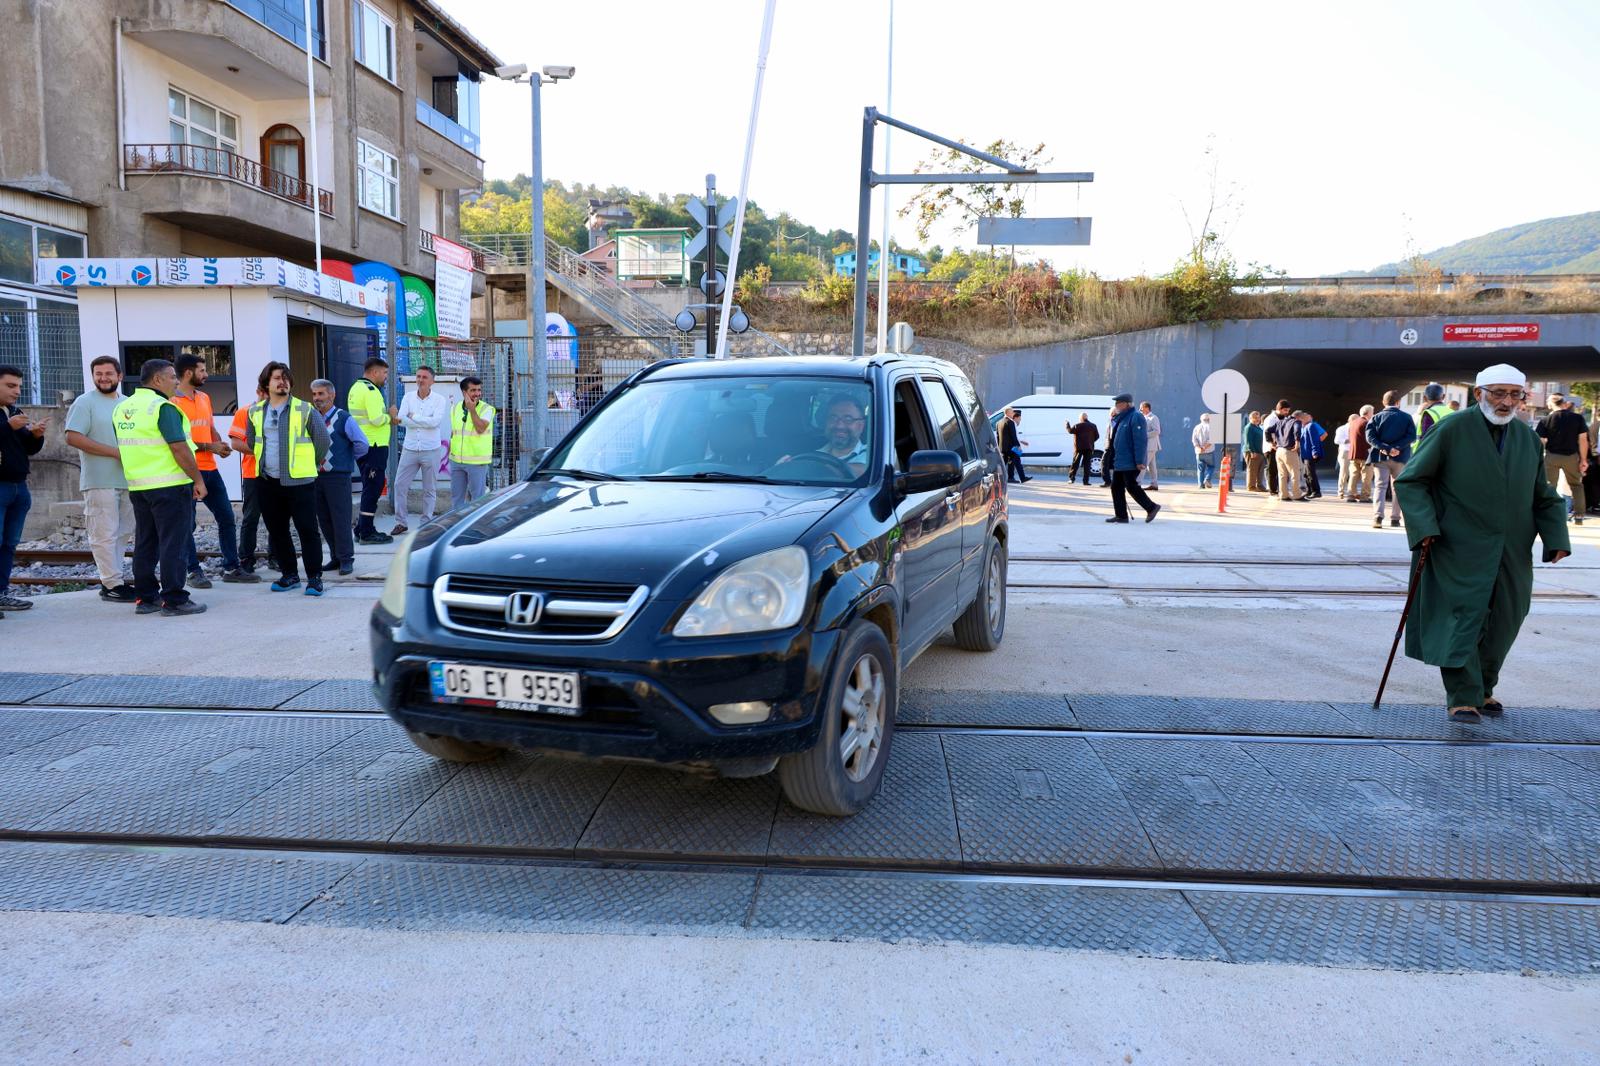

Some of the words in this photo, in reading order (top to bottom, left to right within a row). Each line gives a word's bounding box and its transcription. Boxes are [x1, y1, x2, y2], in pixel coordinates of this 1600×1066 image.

[446, 668, 471, 693] 06
[484, 670, 508, 697] EY
[522, 675, 573, 703] 9559
